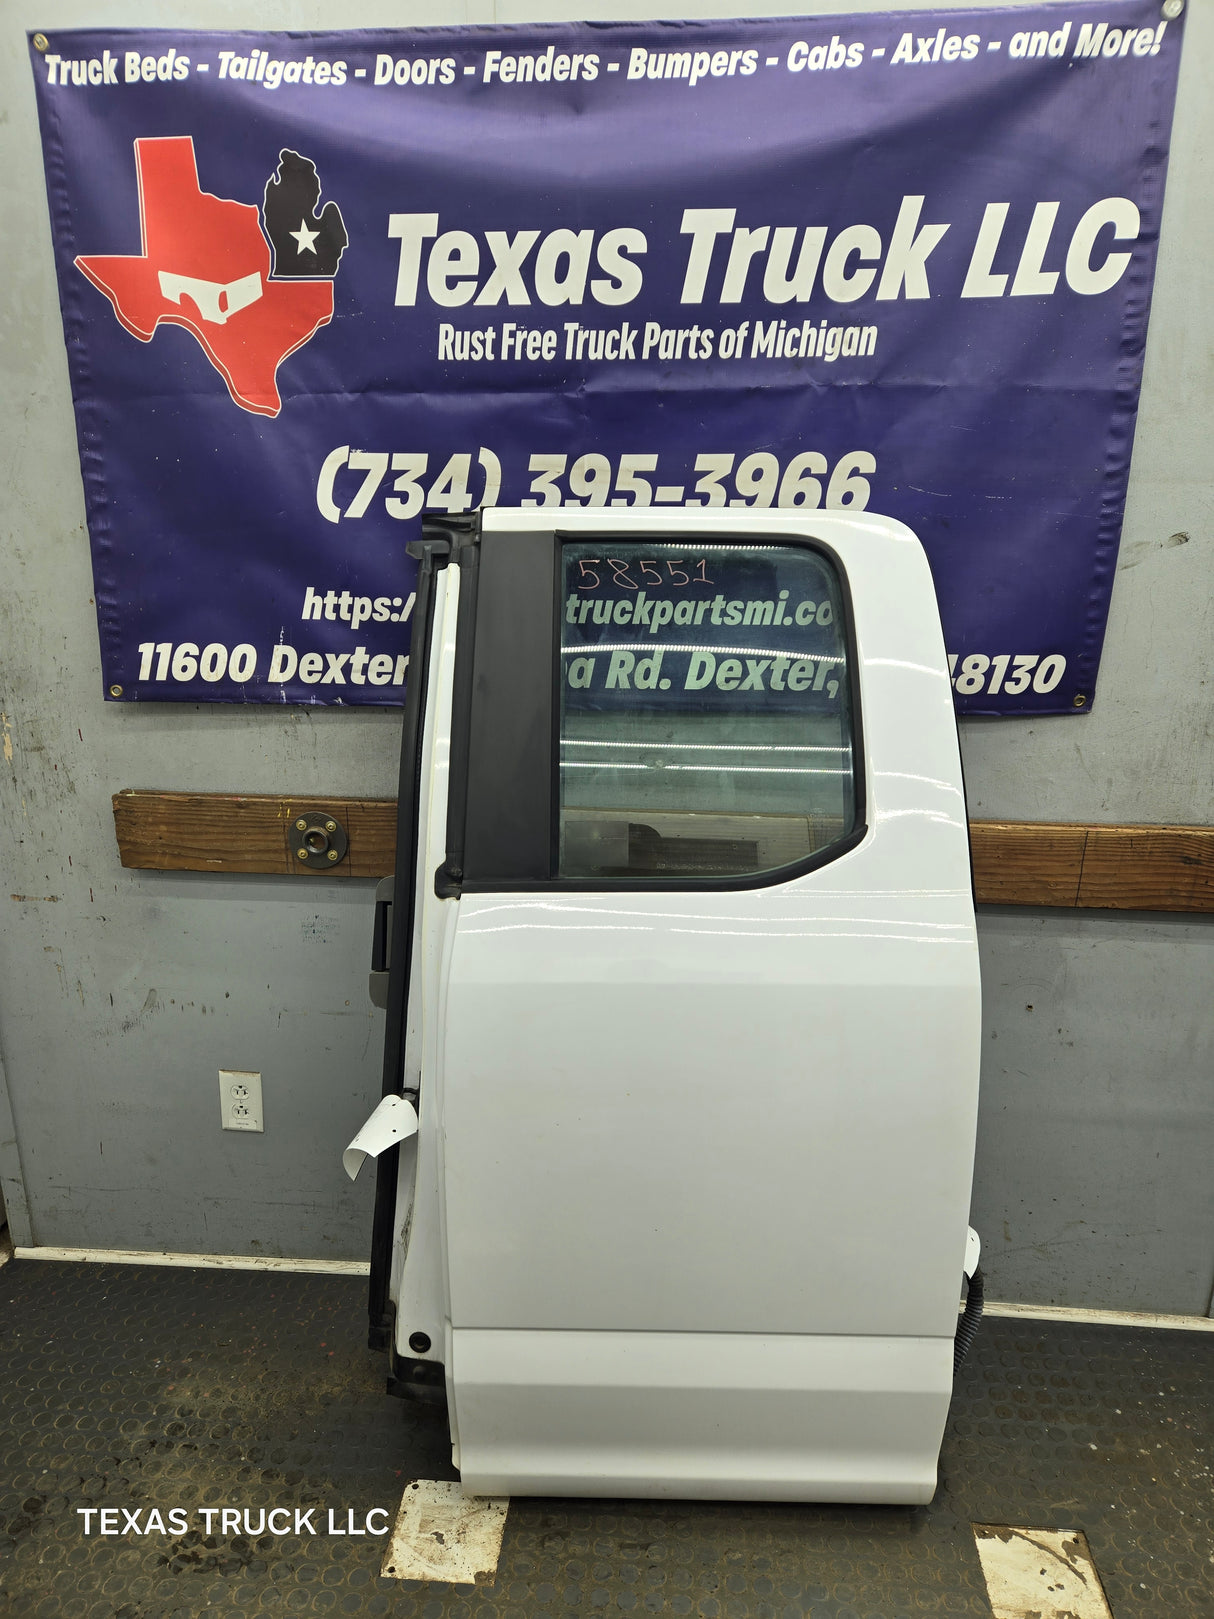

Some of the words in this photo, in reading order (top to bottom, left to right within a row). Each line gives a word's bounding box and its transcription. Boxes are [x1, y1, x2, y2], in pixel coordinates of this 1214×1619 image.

[44, 50, 119, 86] Truck
[124, 49, 190, 82] Beds
[217, 51, 348, 89] Tailgates
[373, 54, 456, 85] Doors
[482, 46, 600, 83] Fenders
[626, 47, 759, 87] Bumpers
[786, 36, 865, 72] Cabs
[889, 28, 981, 65] Axles
[1008, 22, 1072, 58] and
[1073, 21, 1168, 58] More!
[387, 212, 648, 308] Texas
[679, 195, 952, 305] Truck
[960, 197, 1141, 299] LLC
[438, 323, 496, 361] Rust
[501, 323, 557, 361] Free
[563, 320, 639, 361] Truck
[641, 322, 715, 360] Parts
[718, 321, 749, 359] of
[750, 320, 878, 364] Michigan
[316, 445, 501, 524] (734)
[521, 450, 878, 511] 395-3966
[577, 558, 715, 590] 58551
[137, 642, 258, 683] 11600
[267, 644, 410, 686] Dexter
[604, 649, 673, 690] Rd.
[684, 650, 840, 699] Dexter,
